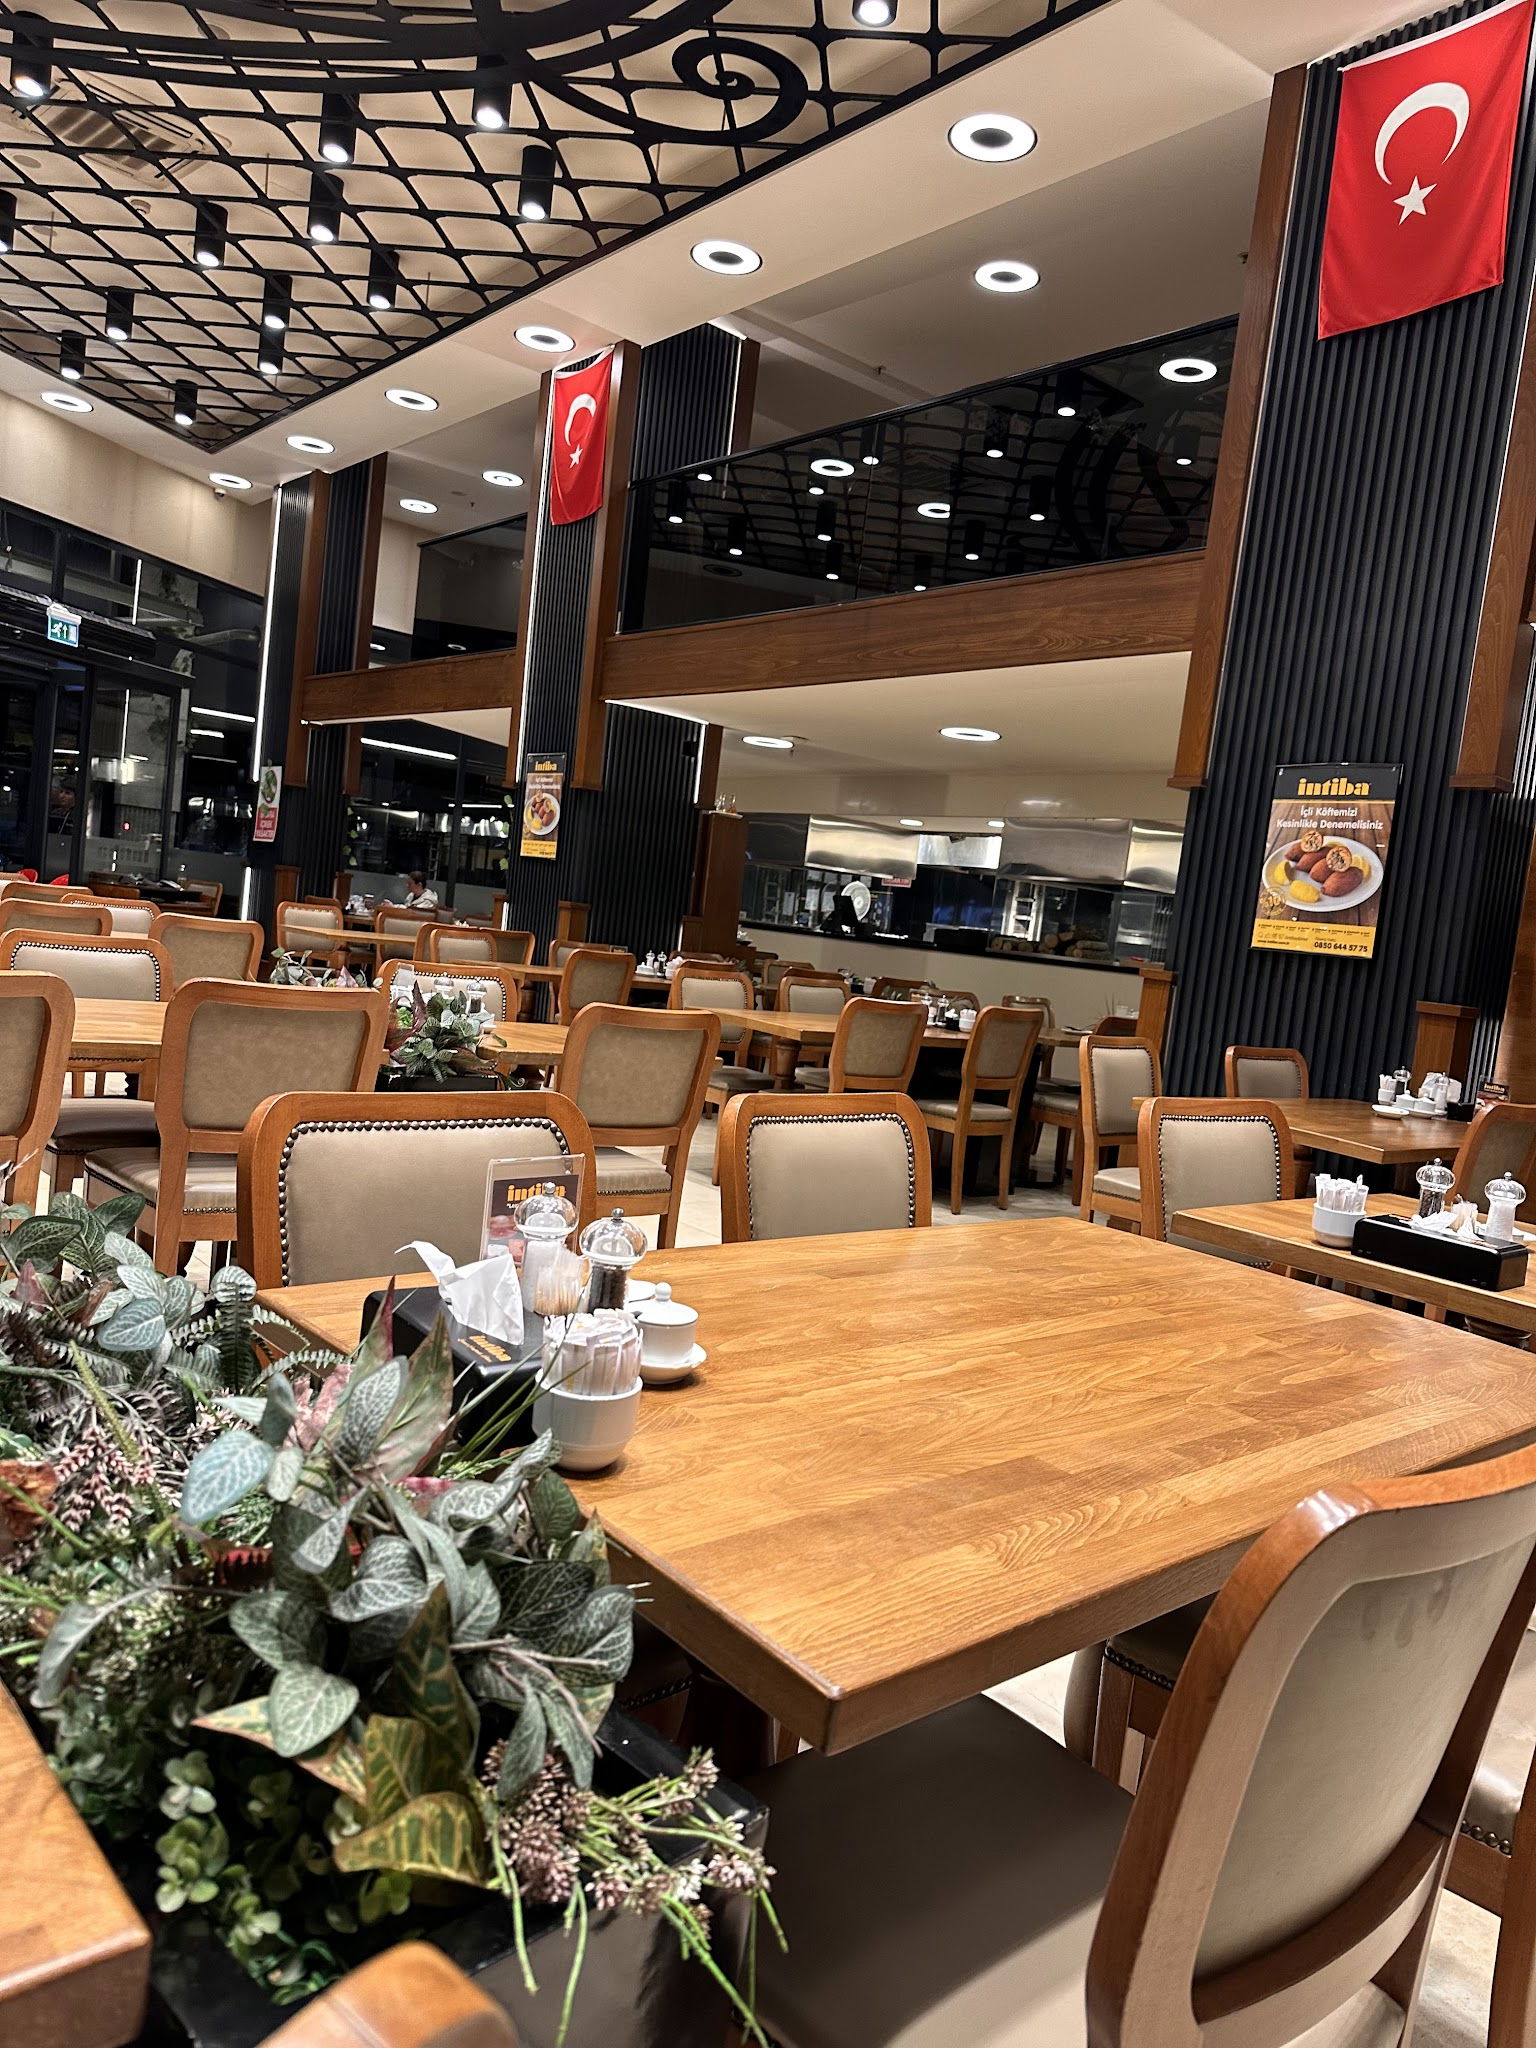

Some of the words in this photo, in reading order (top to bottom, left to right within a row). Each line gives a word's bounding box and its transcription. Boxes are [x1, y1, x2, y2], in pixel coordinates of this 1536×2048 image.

[1297, 777, 1370, 796] intiba
[1300, 805, 1314, 818] İçli
[1315, 807, 1358, 817] Köftemizi
[1276, 819, 1318, 829] Kesinlikle
[1319, 820, 1384, 830] Denemelisiniz
[1314, 941, 1332, 949] 0850
[1348, 944, 1358, 952] 57
[507, 1182, 567, 1202] intia
